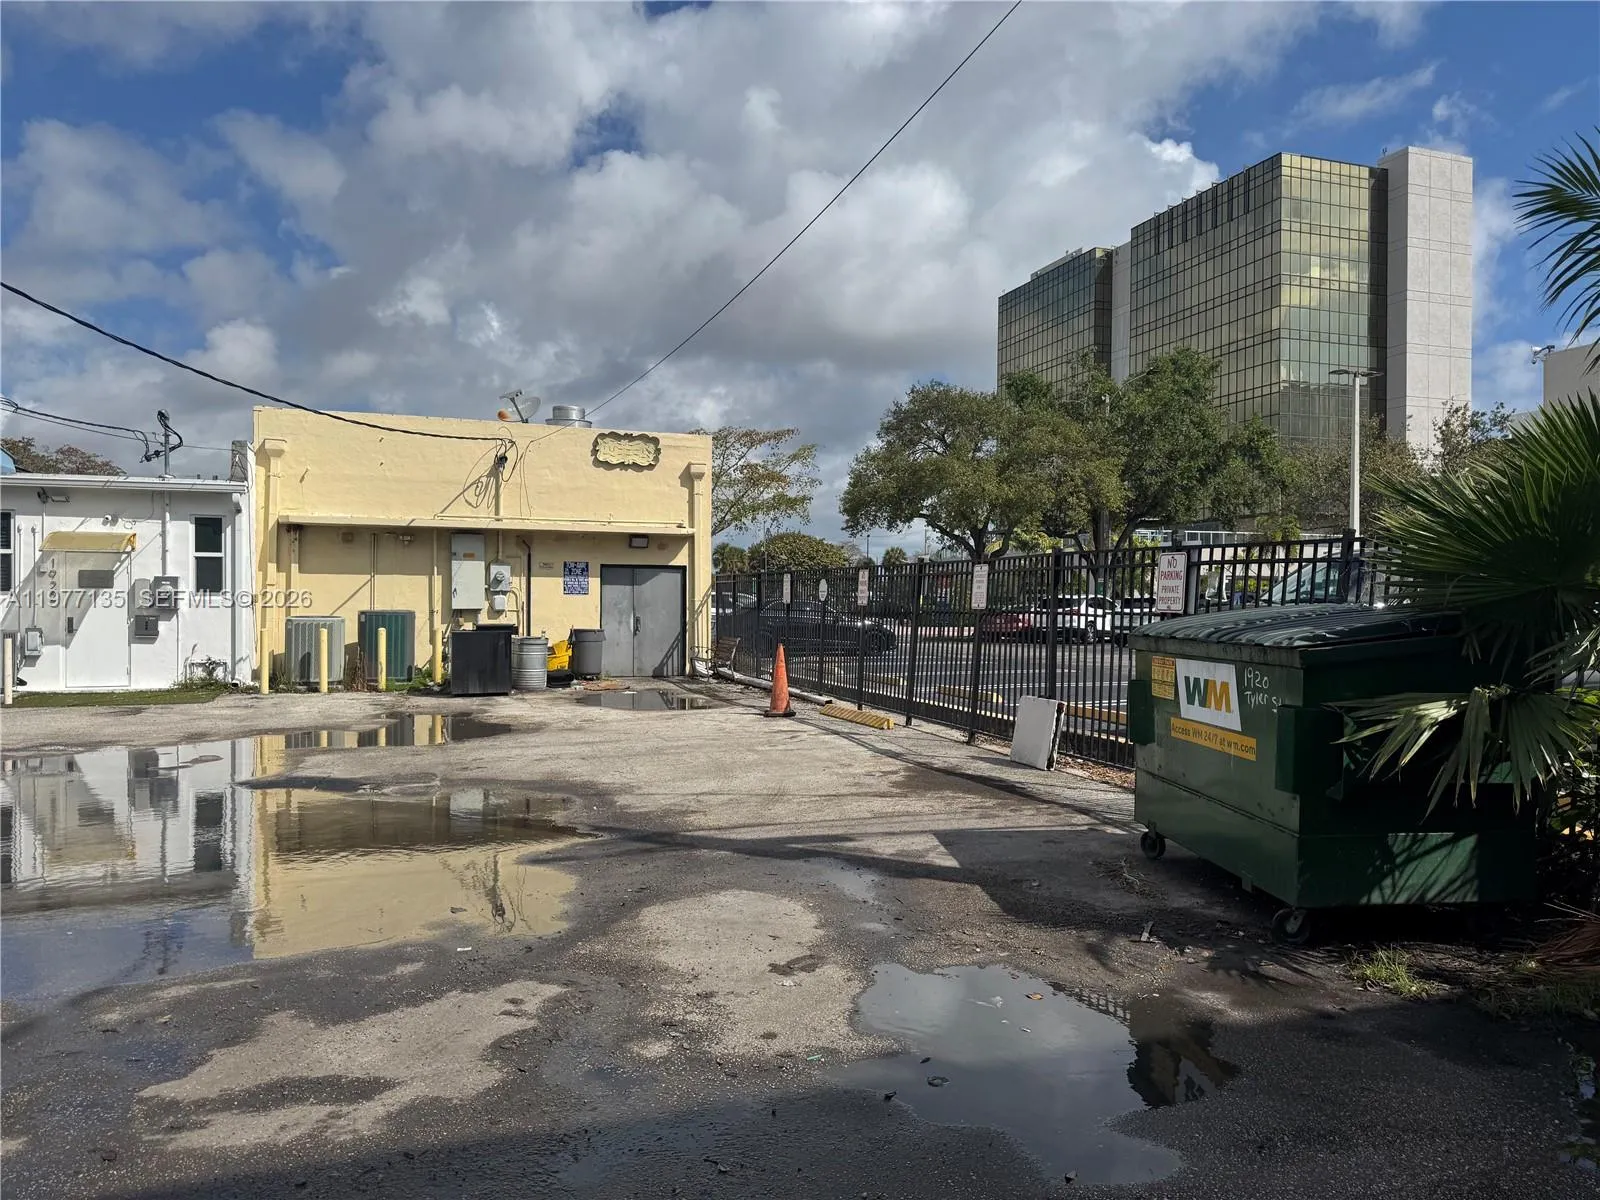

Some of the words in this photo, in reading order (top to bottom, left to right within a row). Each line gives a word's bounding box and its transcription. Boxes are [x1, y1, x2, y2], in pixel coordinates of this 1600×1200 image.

[1167, 558, 1178, 569] NO
[1160, 570, 1183, 581] PARKING
[1161, 585, 1180, 594] PRIVATE
[1158, 596, 1181, 605] PROPERTY
[1243, 666, 1269, 689] 1920
[1183, 675, 1232, 714] WM
[1243, 691, 1269, 709] Tyler
[1171, 722, 1191, 737] Access
[1191, 727, 1203, 740] WM
[1203, 729, 1219, 745] 24/7
[1219, 737, 1226, 748] at
[1226, 740, 1256, 756] wm.com
